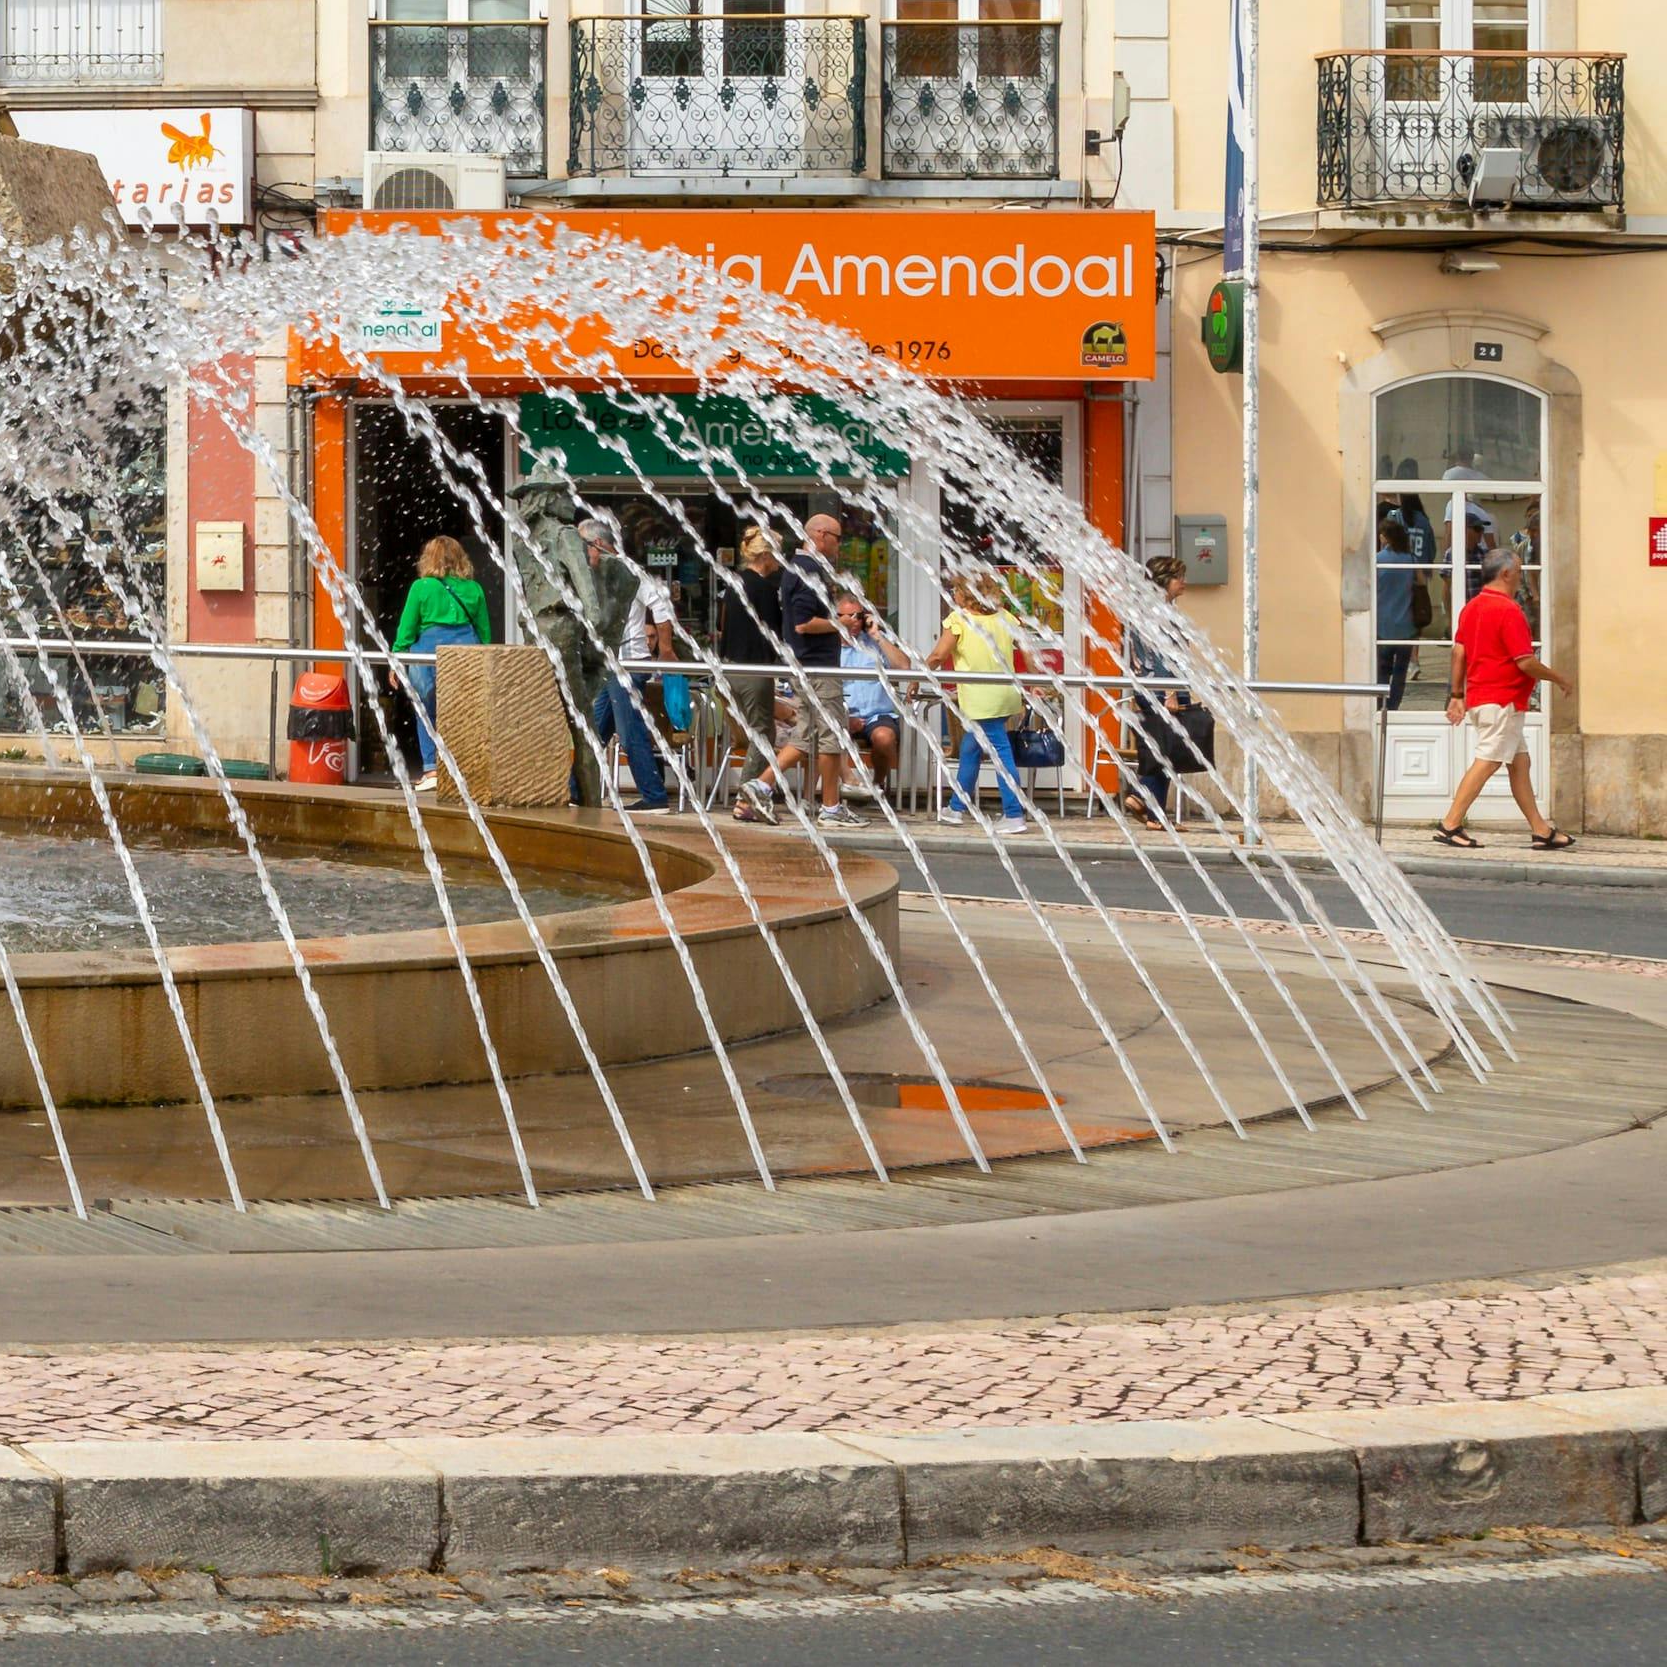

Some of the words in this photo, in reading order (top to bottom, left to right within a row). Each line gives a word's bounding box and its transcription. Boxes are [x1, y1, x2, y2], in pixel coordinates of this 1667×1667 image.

[784, 243, 1134, 297] Amendoal
[896, 340, 952, 360] 1976
[1479, 346, 1497, 357] 24
[1084, 354, 1125, 363] CAMELO
